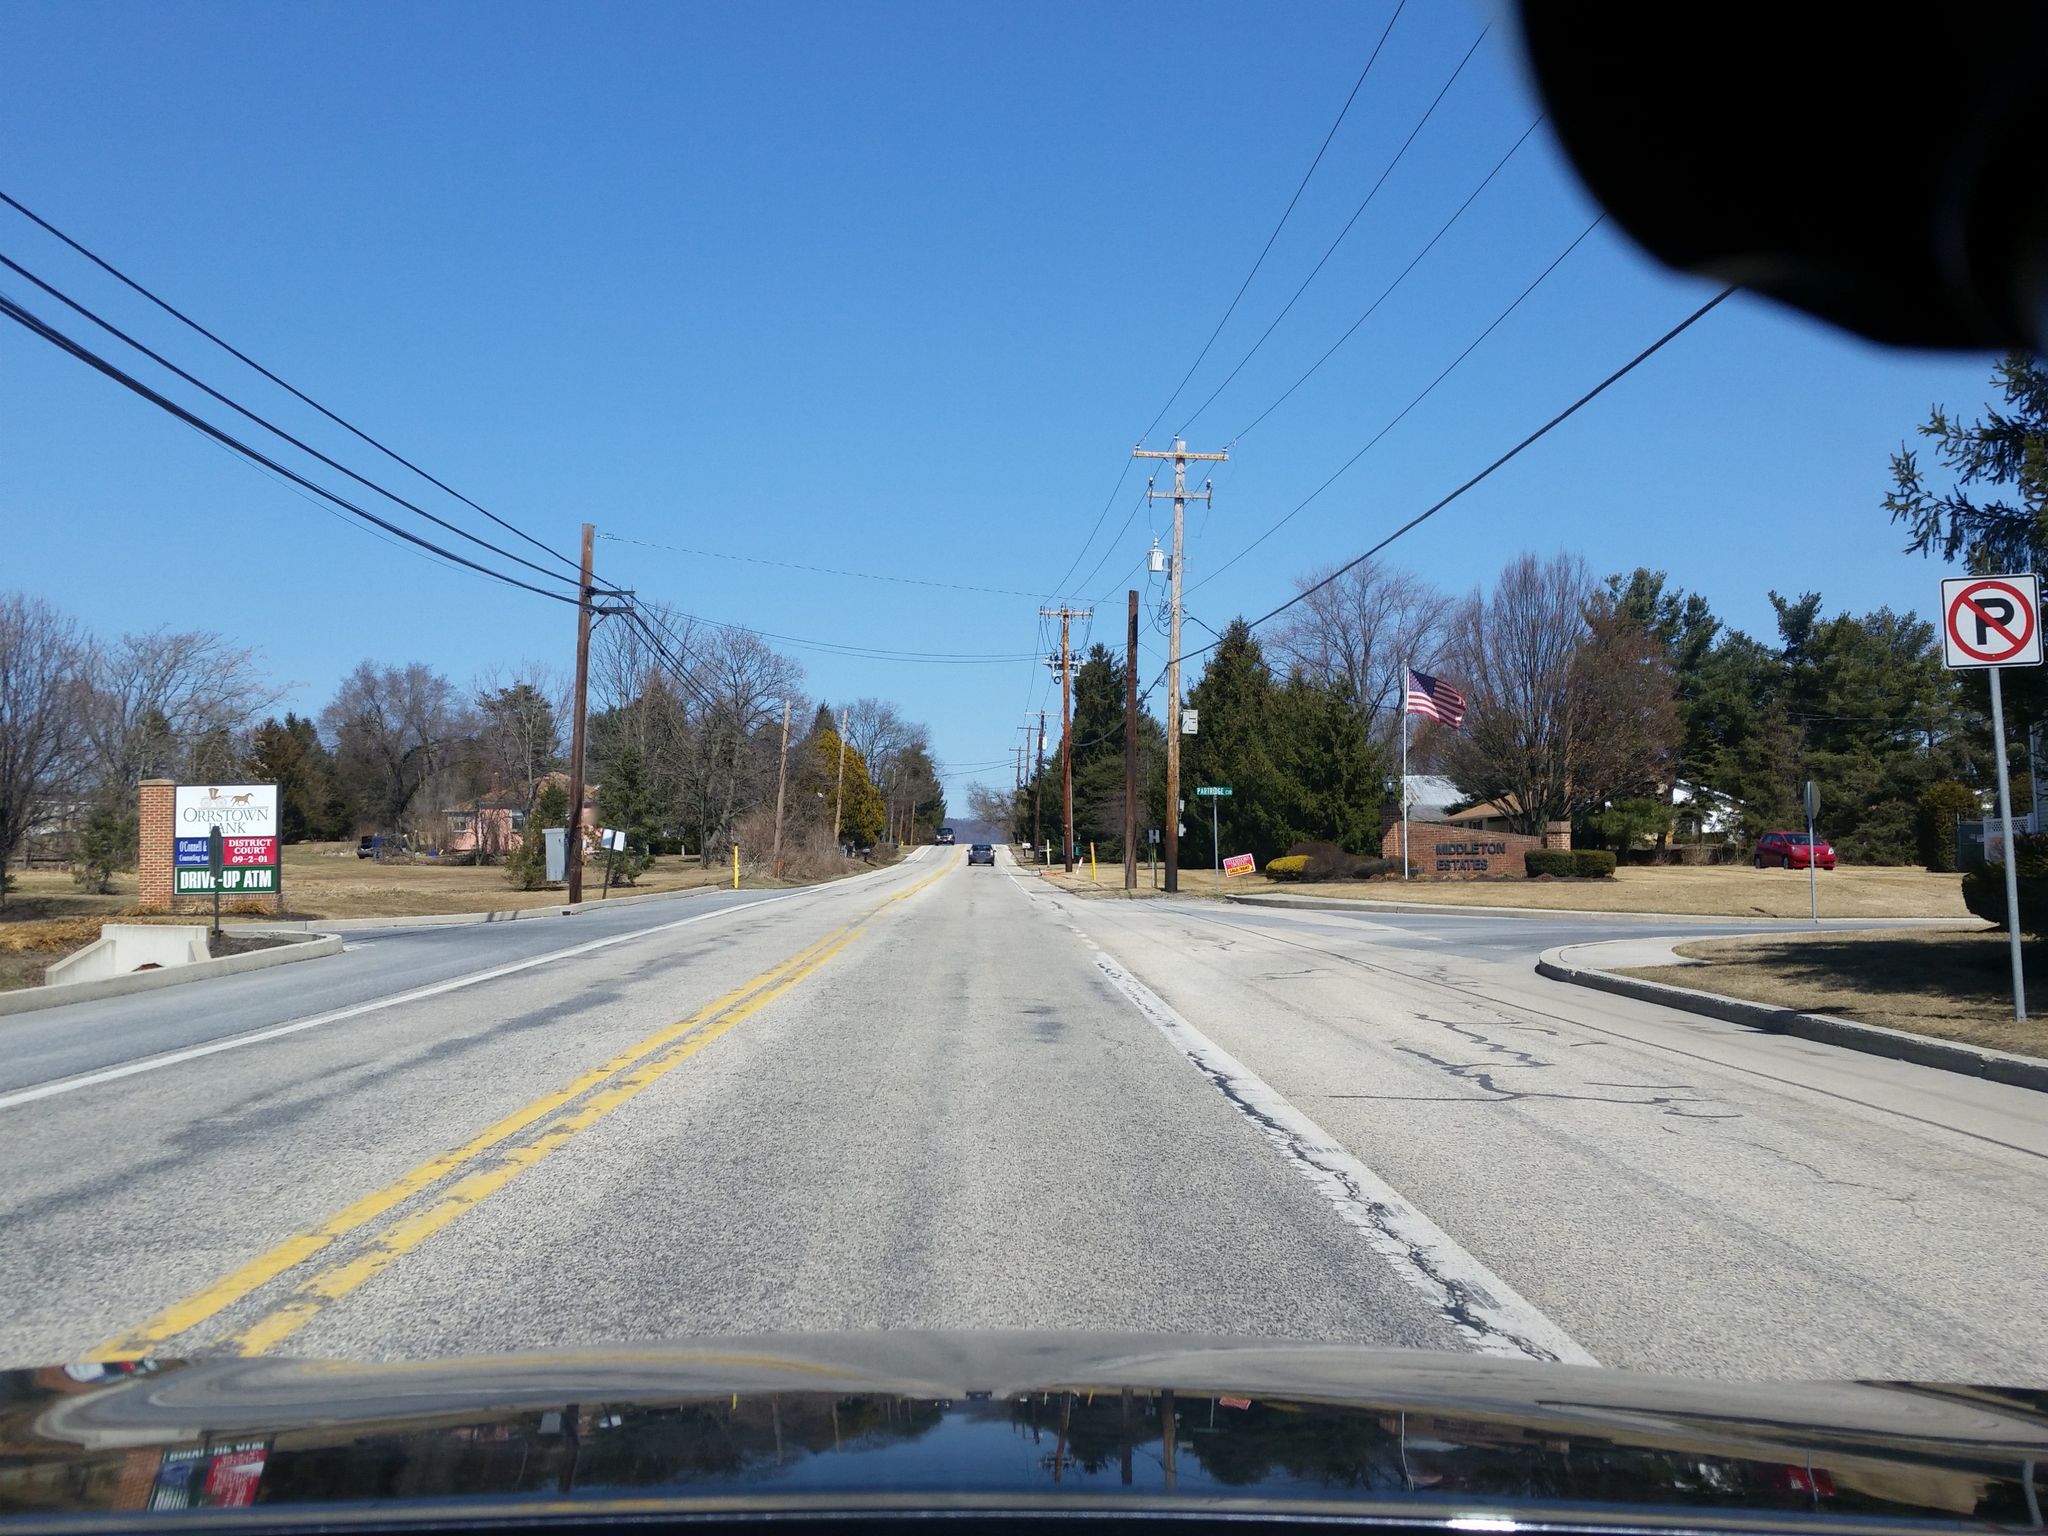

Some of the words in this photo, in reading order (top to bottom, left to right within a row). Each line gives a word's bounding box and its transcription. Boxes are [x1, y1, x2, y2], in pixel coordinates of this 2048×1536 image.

[1974, 598, 2015, 645] P
[1196, 787, 1224, 795] PARTRIDGE
[183, 808, 268, 822] ORRSTOWN
[229, 839, 272, 847] DISTRICT
[1436, 842, 1506, 855] MIDDLETON
[1437, 859, 1488, 871] ESTATES
[243, 870, 271, 888] ATM
